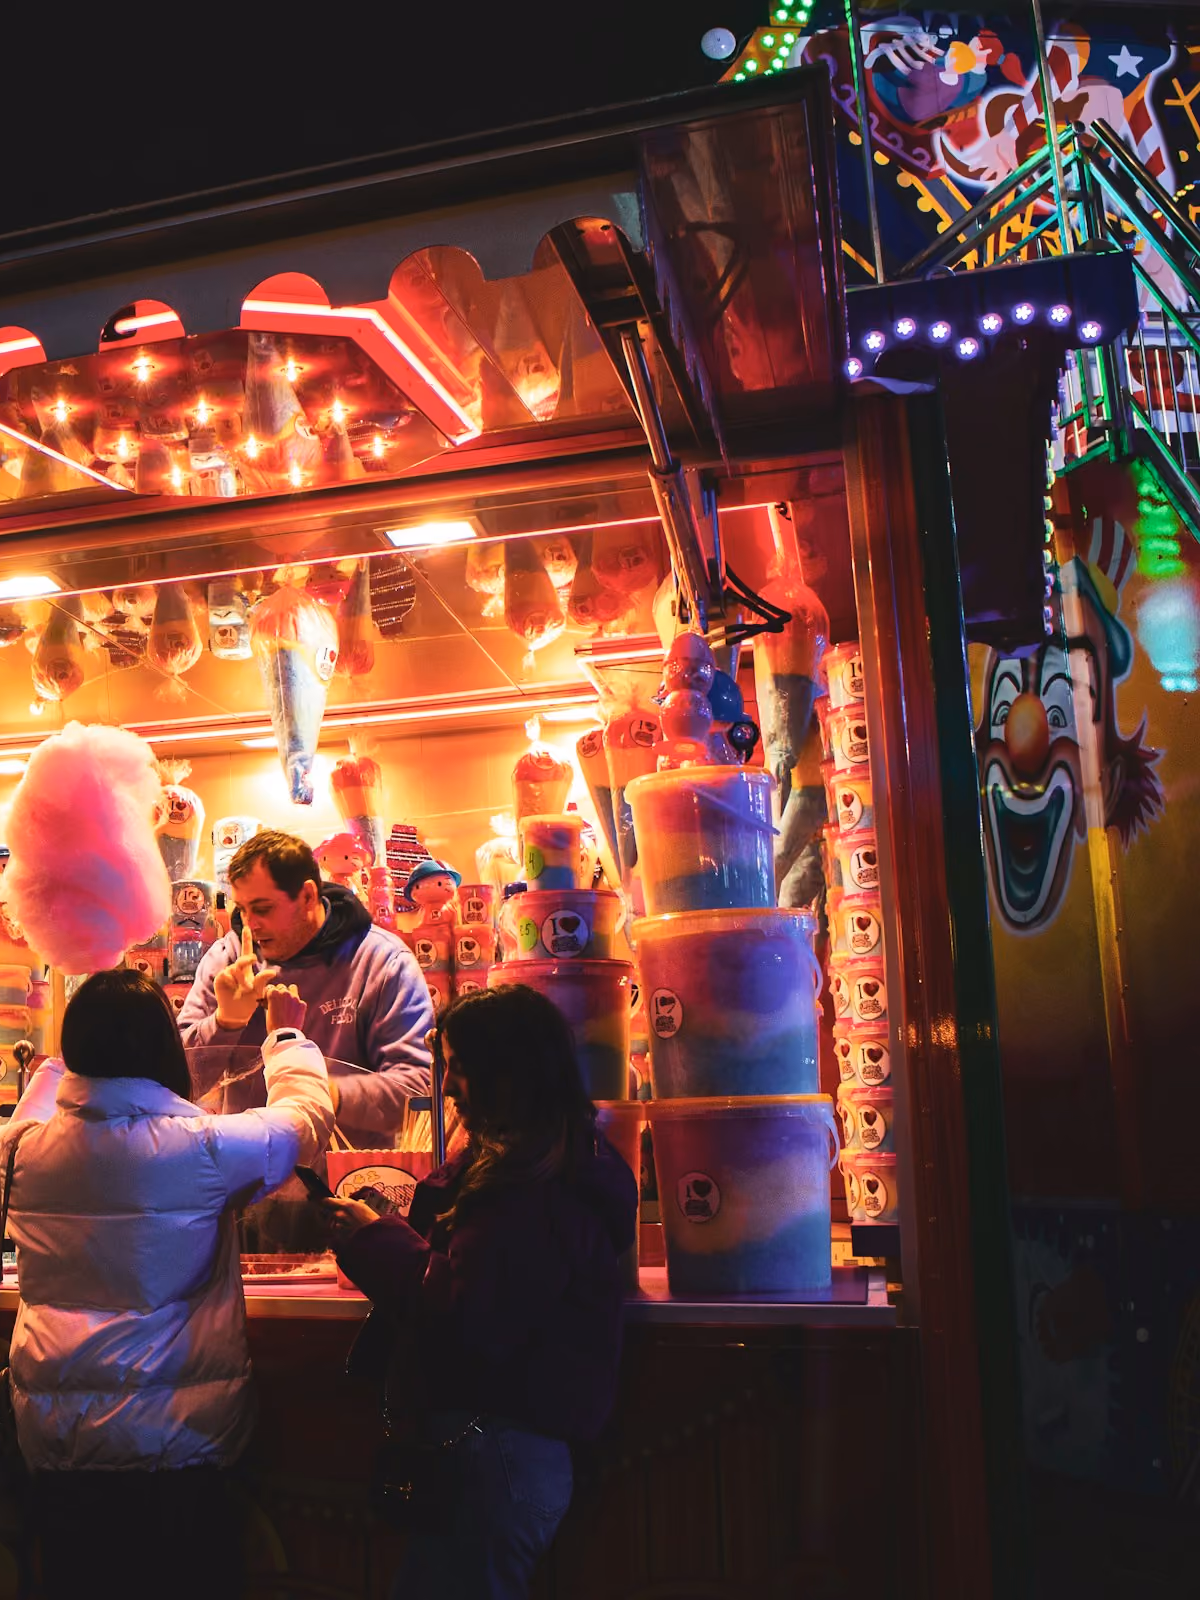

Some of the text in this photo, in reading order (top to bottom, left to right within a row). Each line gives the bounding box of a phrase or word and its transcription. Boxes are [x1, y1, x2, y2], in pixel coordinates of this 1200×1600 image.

[850, 662, 856, 677] I
[855, 853, 862, 869] I
[550, 918, 558, 936] I
[857, 984, 862, 999] I
[861, 1047, 866, 1064] I
[860, 1113, 865, 1130] I
